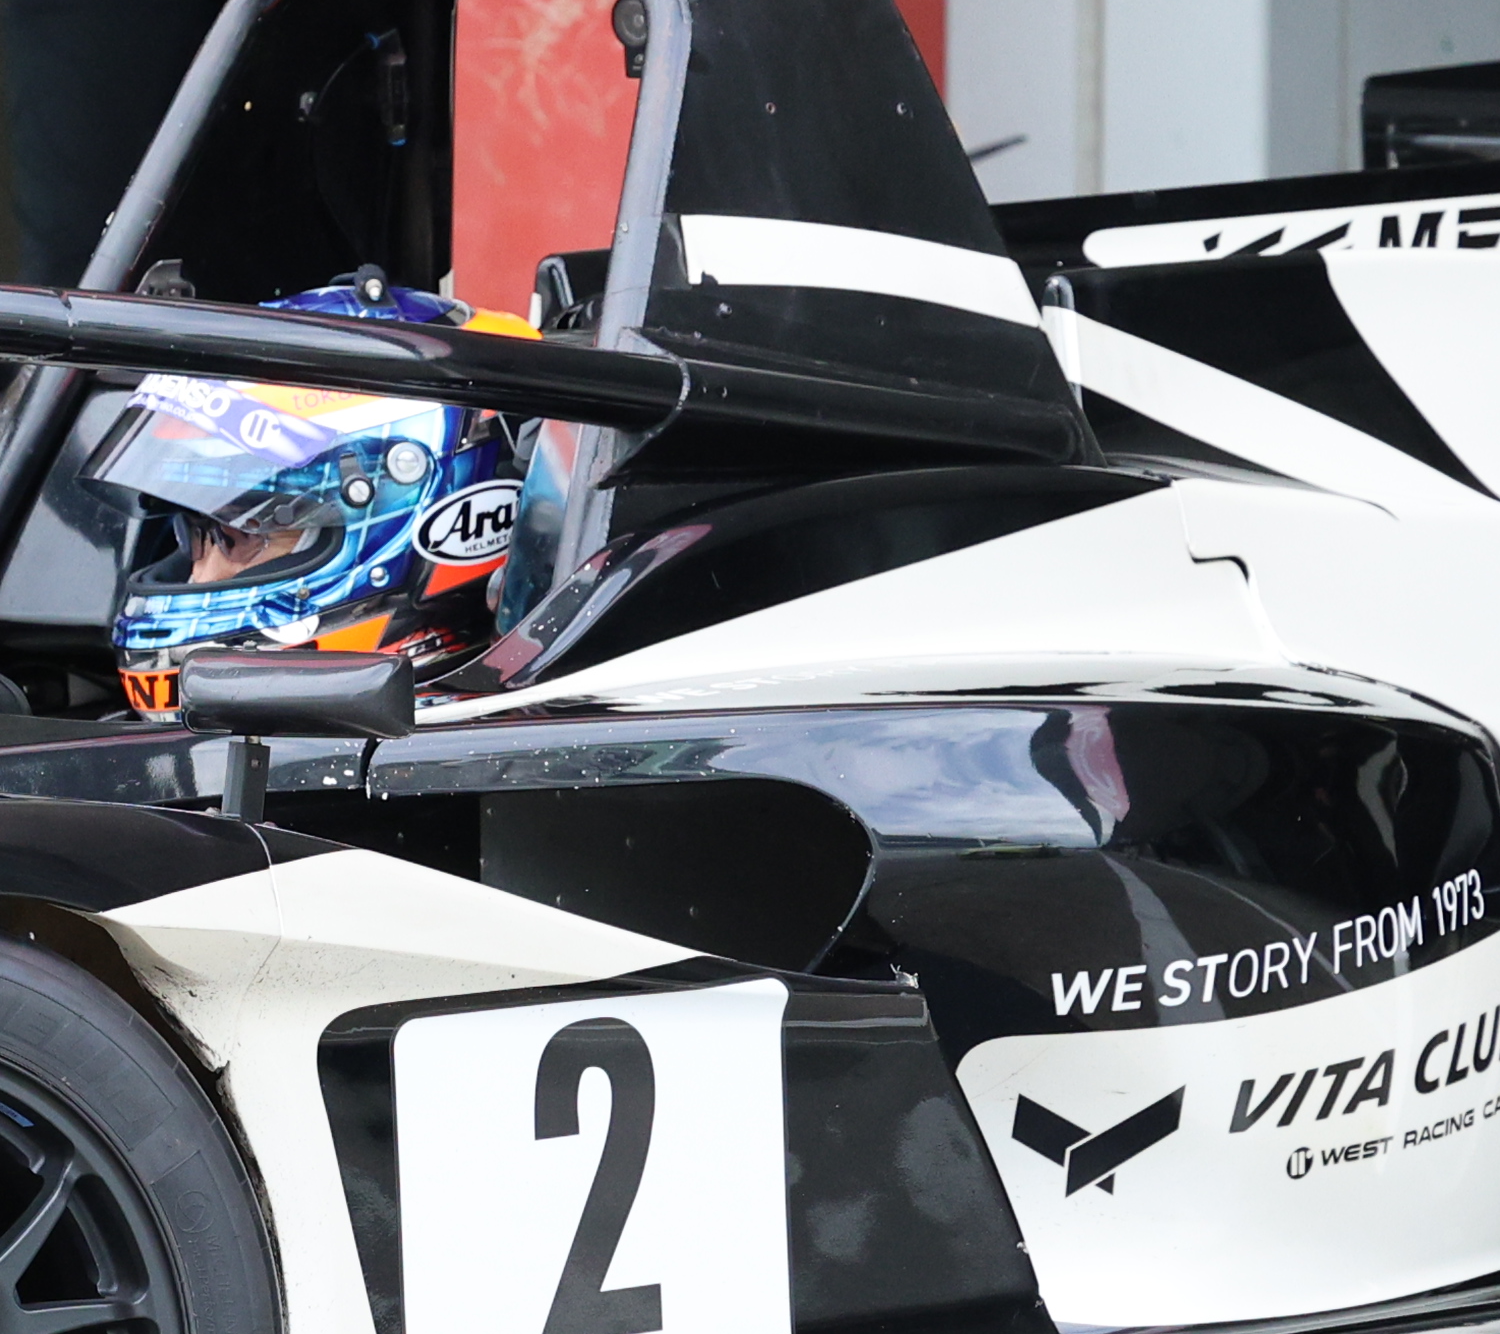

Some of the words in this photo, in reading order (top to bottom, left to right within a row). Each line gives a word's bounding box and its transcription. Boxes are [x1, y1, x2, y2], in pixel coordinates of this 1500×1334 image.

[1050, 964, 1148, 1017] WE
[1157, 931, 1319, 1008] STORY
[1331, 895, 1425, 975] FROM
[1431, 867, 1486, 937] 1973
[1228, 1047, 1396, 1134] VITA
[1320, 1135, 1394, 1167] WEST
[1402, 1108, 1475, 1149] RACING
